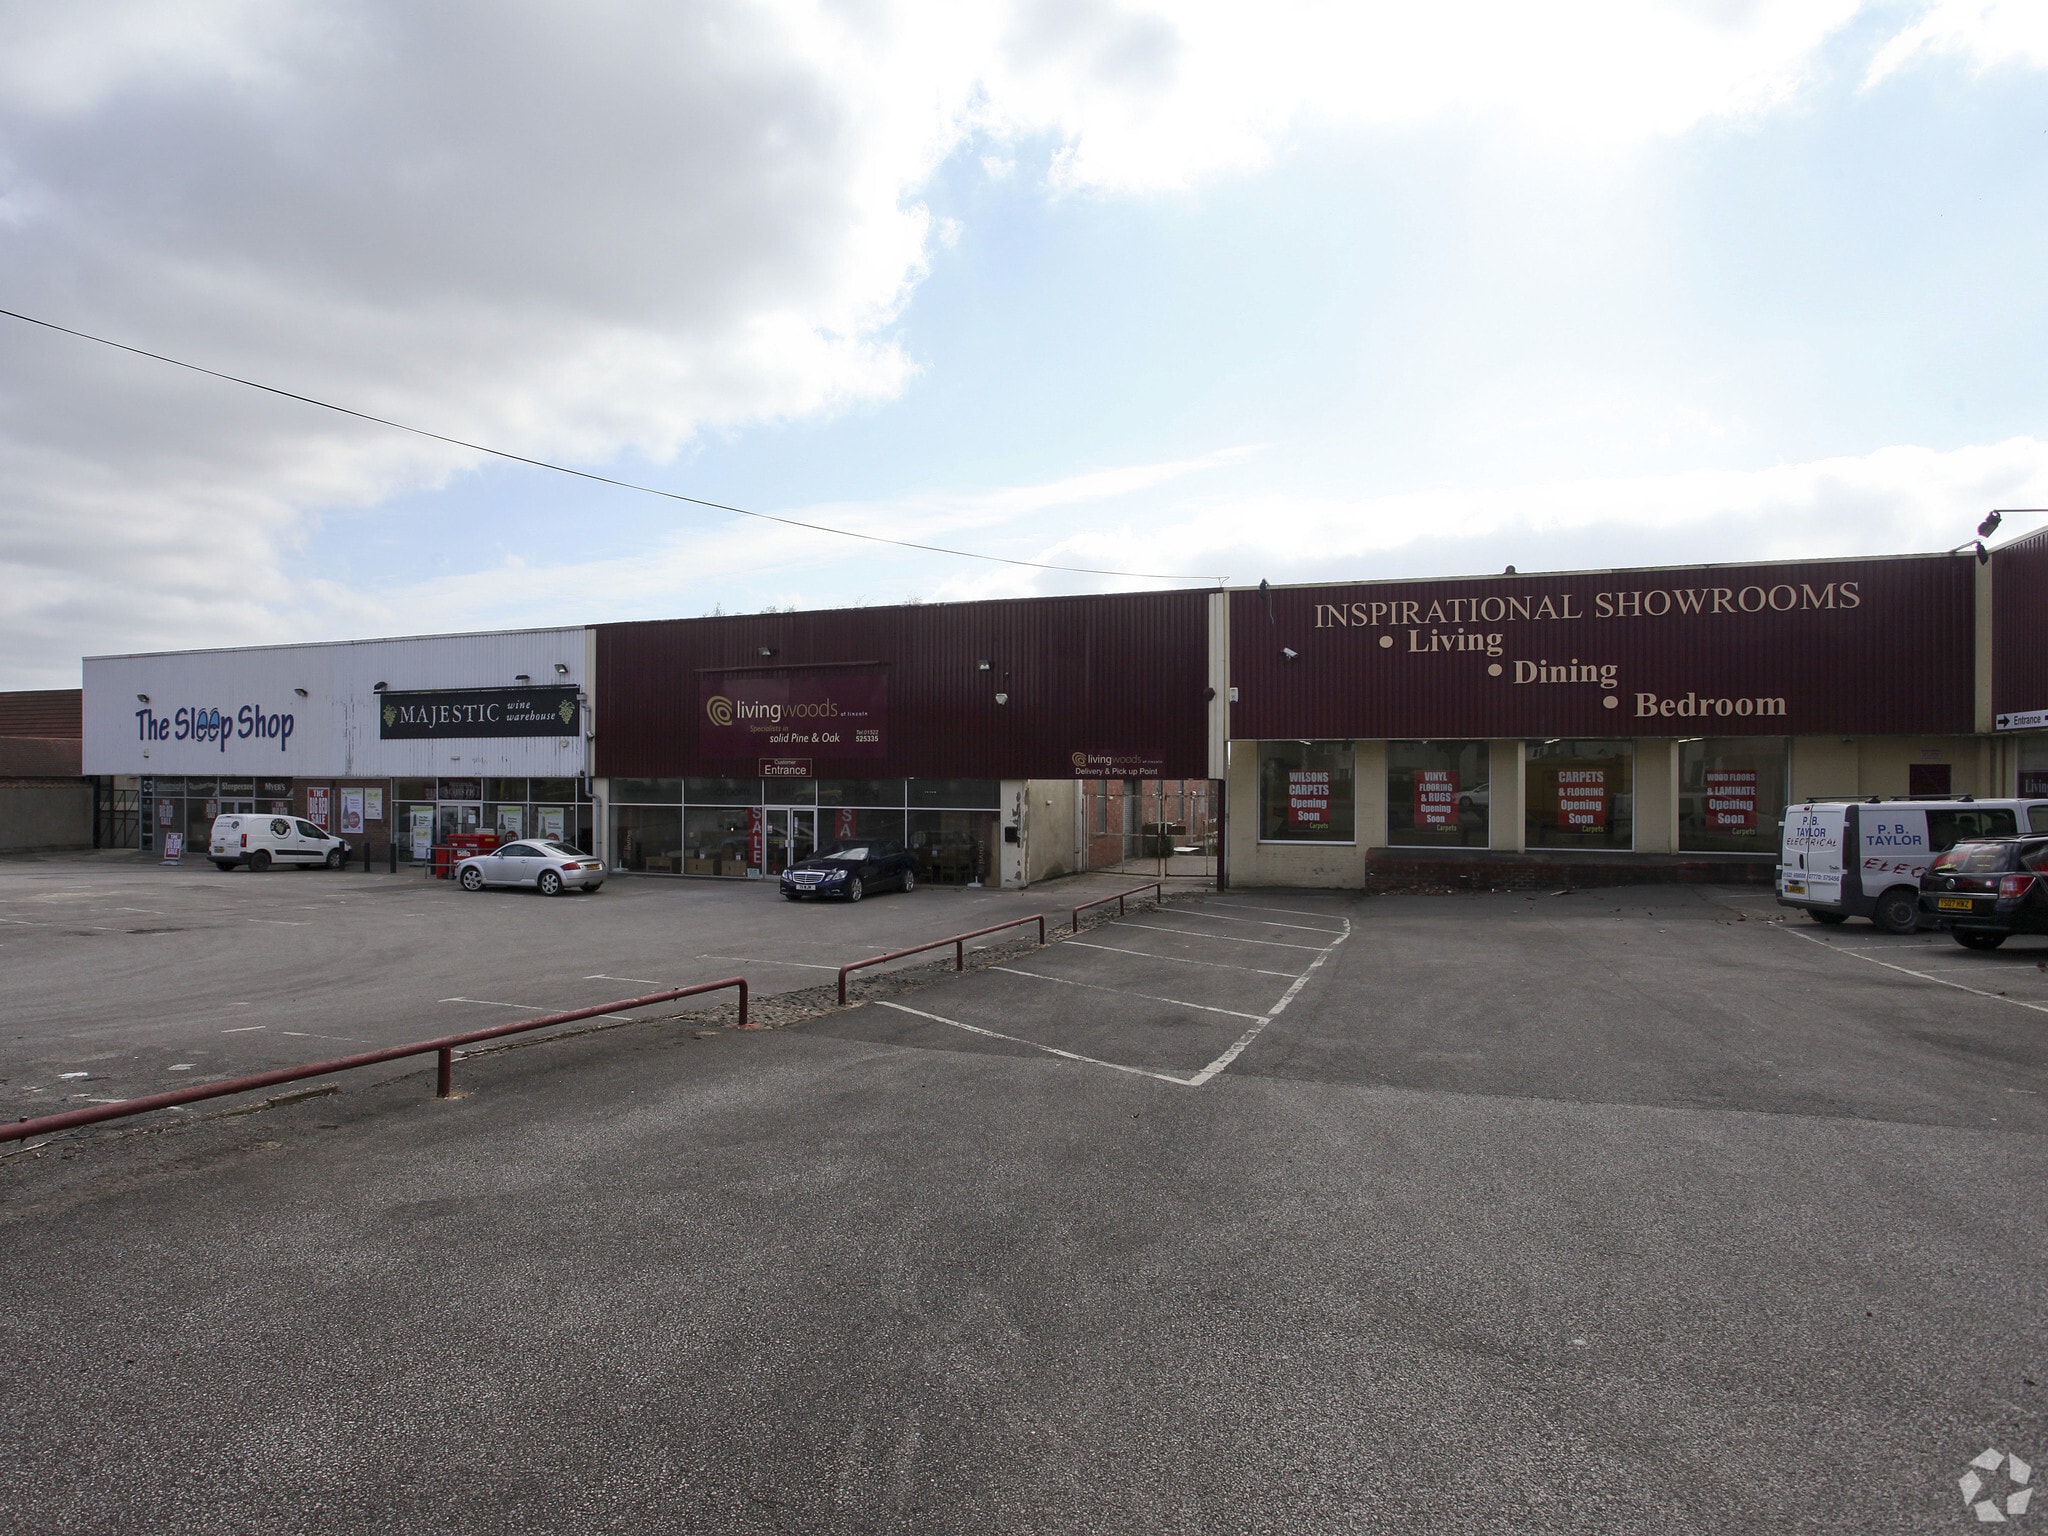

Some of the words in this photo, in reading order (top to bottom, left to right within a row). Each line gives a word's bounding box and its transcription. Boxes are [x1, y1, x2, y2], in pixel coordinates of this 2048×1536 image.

[1314, 594, 1583, 629] INSPIRATIONAL
[1594, 581, 1861, 618] SHOWROOMS
[1407, 628, 1503, 657] Living
[1512, 658, 1618, 689] Dining
[507, 700, 530, 710] wine
[736, 698, 839, 723] livingwoods
[1634, 692, 1788, 719] Bedroom
[399, 703, 500, 728] MAJESTIC
[506, 711, 556, 721] warehouse
[2013, 715, 2042, 726] Entrance
[135, 708, 170, 741] The
[174, 707, 233, 752] Sleep
[237, 704, 294, 751] Shop
[750, 725, 780, 733] Specialists
[770, 734, 789, 743] solid
[791, 733, 809, 743] Pine
[811, 733, 820, 743] &
[821, 732, 841, 743] Oak
[764, 764, 807, 775] Entrance
[1075, 767, 1103, 776] Delivery
[1112, 767, 1127, 775] Pick
[1139, 767, 1158, 775] Point
[1289, 772, 1329, 783] WILSONS
[1424, 771, 1447, 782] VINYL
[1558, 771, 1604, 783] CARPETS
[1706, 773, 1727, 781] WOOD
[1729, 773, 1756, 781] FLOORS
[313, 789, 324, 797] THE
[1289, 784, 1329, 796] CARPETS
[1419, 784, 1452, 792] FLOORING
[1558, 788, 1565, 796] &
[1567, 788, 1604, 796] FLOORING
[1706, 787, 1713, 795] &
[1715, 786, 1756, 796] LAMINATE
[1421, 794, 1427, 802] &
[1428, 793, 1451, 802] RUGS
[1291, 798, 1327, 809] Opening
[1420, 804, 1451, 813] Opening
[1560, 800, 1602, 811] Opening
[1708, 799, 1753, 810] Opening
[1298, 811, 1320, 821] Soon
[1426, 815, 1445, 823] Soon
[1568, 813, 1594, 824] Soon
[1717, 813, 1745, 824] Soon
[1582, 825, 1604, 833] Carpets
[1732, 827, 1756, 835] Carpets
[1796, 827, 1826, 838] TAYLOR
[1866, 834, 1923, 846] TAYLOR
